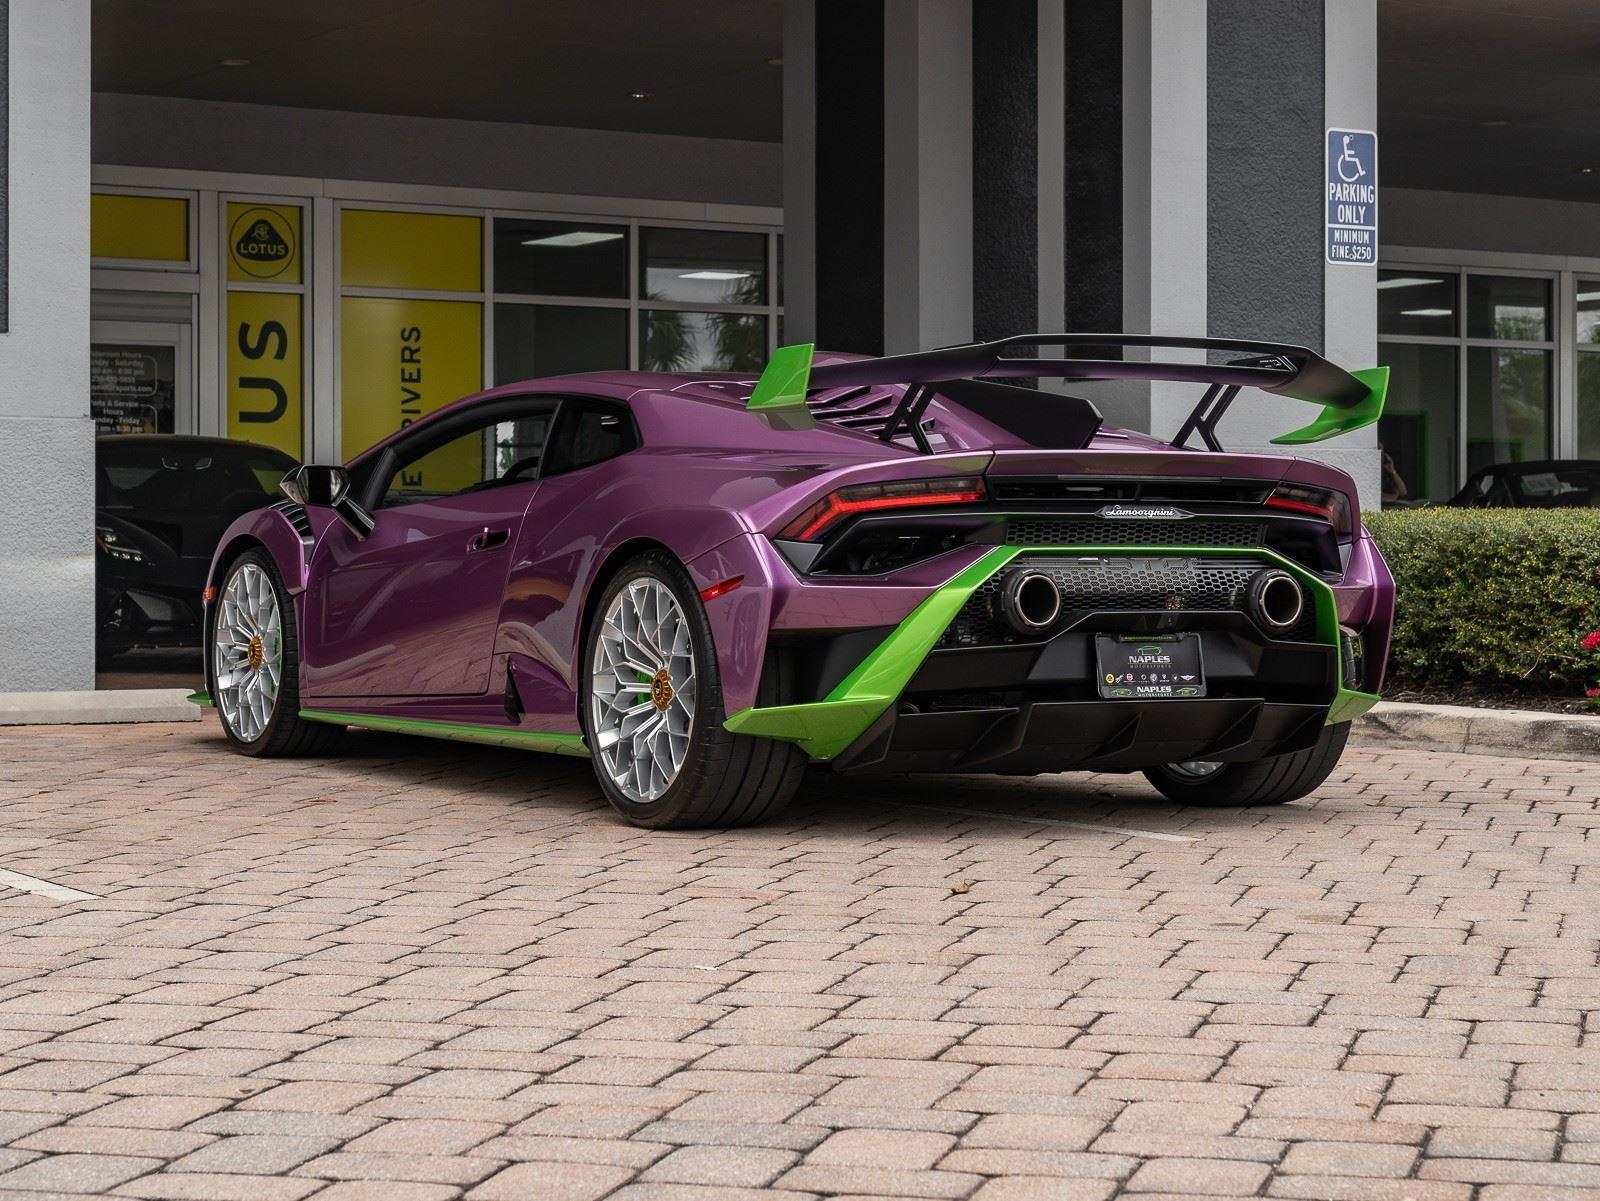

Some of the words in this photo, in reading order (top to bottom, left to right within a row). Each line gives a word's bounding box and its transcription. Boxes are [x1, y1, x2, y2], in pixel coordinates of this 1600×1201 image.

[1329, 183, 1374, 204] PARKING
[1337, 205, 1366, 224] ONLY
[1334, 229, 1370, 244] MINIMUM
[240, 243, 286, 256] LOTUS
[1331, 245, 1350, 260] FINE
[1352, 246, 1372, 260] $250
[103, 408, 124, 416] Hours
[119, 417, 141, 425] Friday
[1105, 504, 1175, 518] Lamborghini
[1128, 655, 1171, 663] NAPLES
